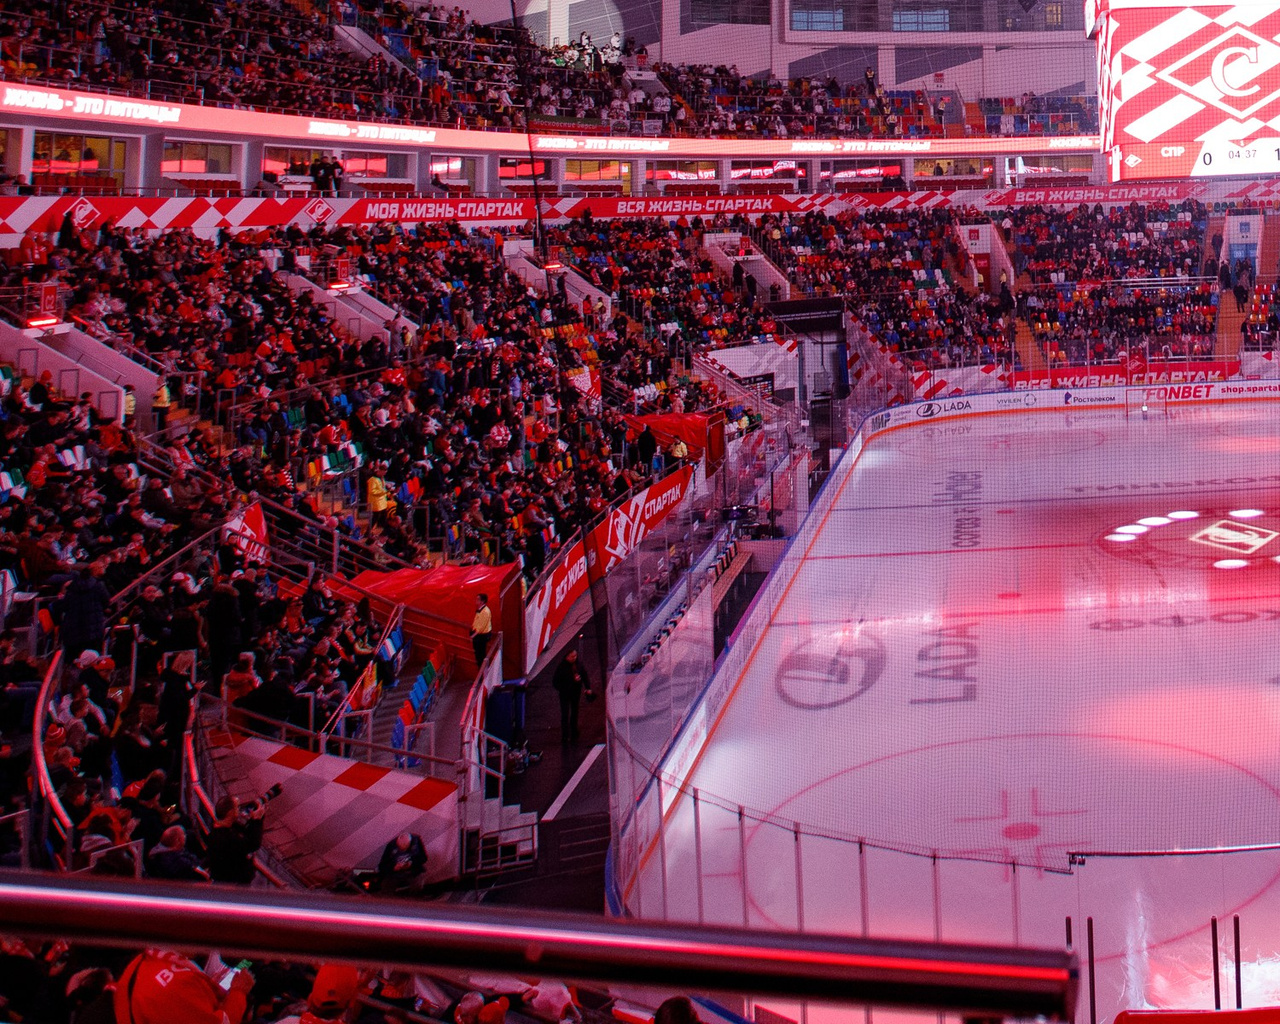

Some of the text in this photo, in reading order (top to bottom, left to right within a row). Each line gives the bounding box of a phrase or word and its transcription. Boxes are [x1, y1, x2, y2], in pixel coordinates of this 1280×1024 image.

[1160, 146, 1185, 157] СПР
[1274, 148, 1280, 161] 1
[1202, 152, 1213, 166] 0
[1015, 190, 1045, 202] ВСЯ
[366, 202, 399, 219] МОЯ
[617, 200, 645, 214] ВСЯ
[1057, 374, 1126, 388] ЖИЗНЬ
[1073, 395, 1115, 404] Ростелеком
[1145, 385, 1214, 401] FONBET
[943, 400, 972, 413] LADA
[644, 483, 681, 520] СПАРТАК
[909, 622, 980, 705] LADA
